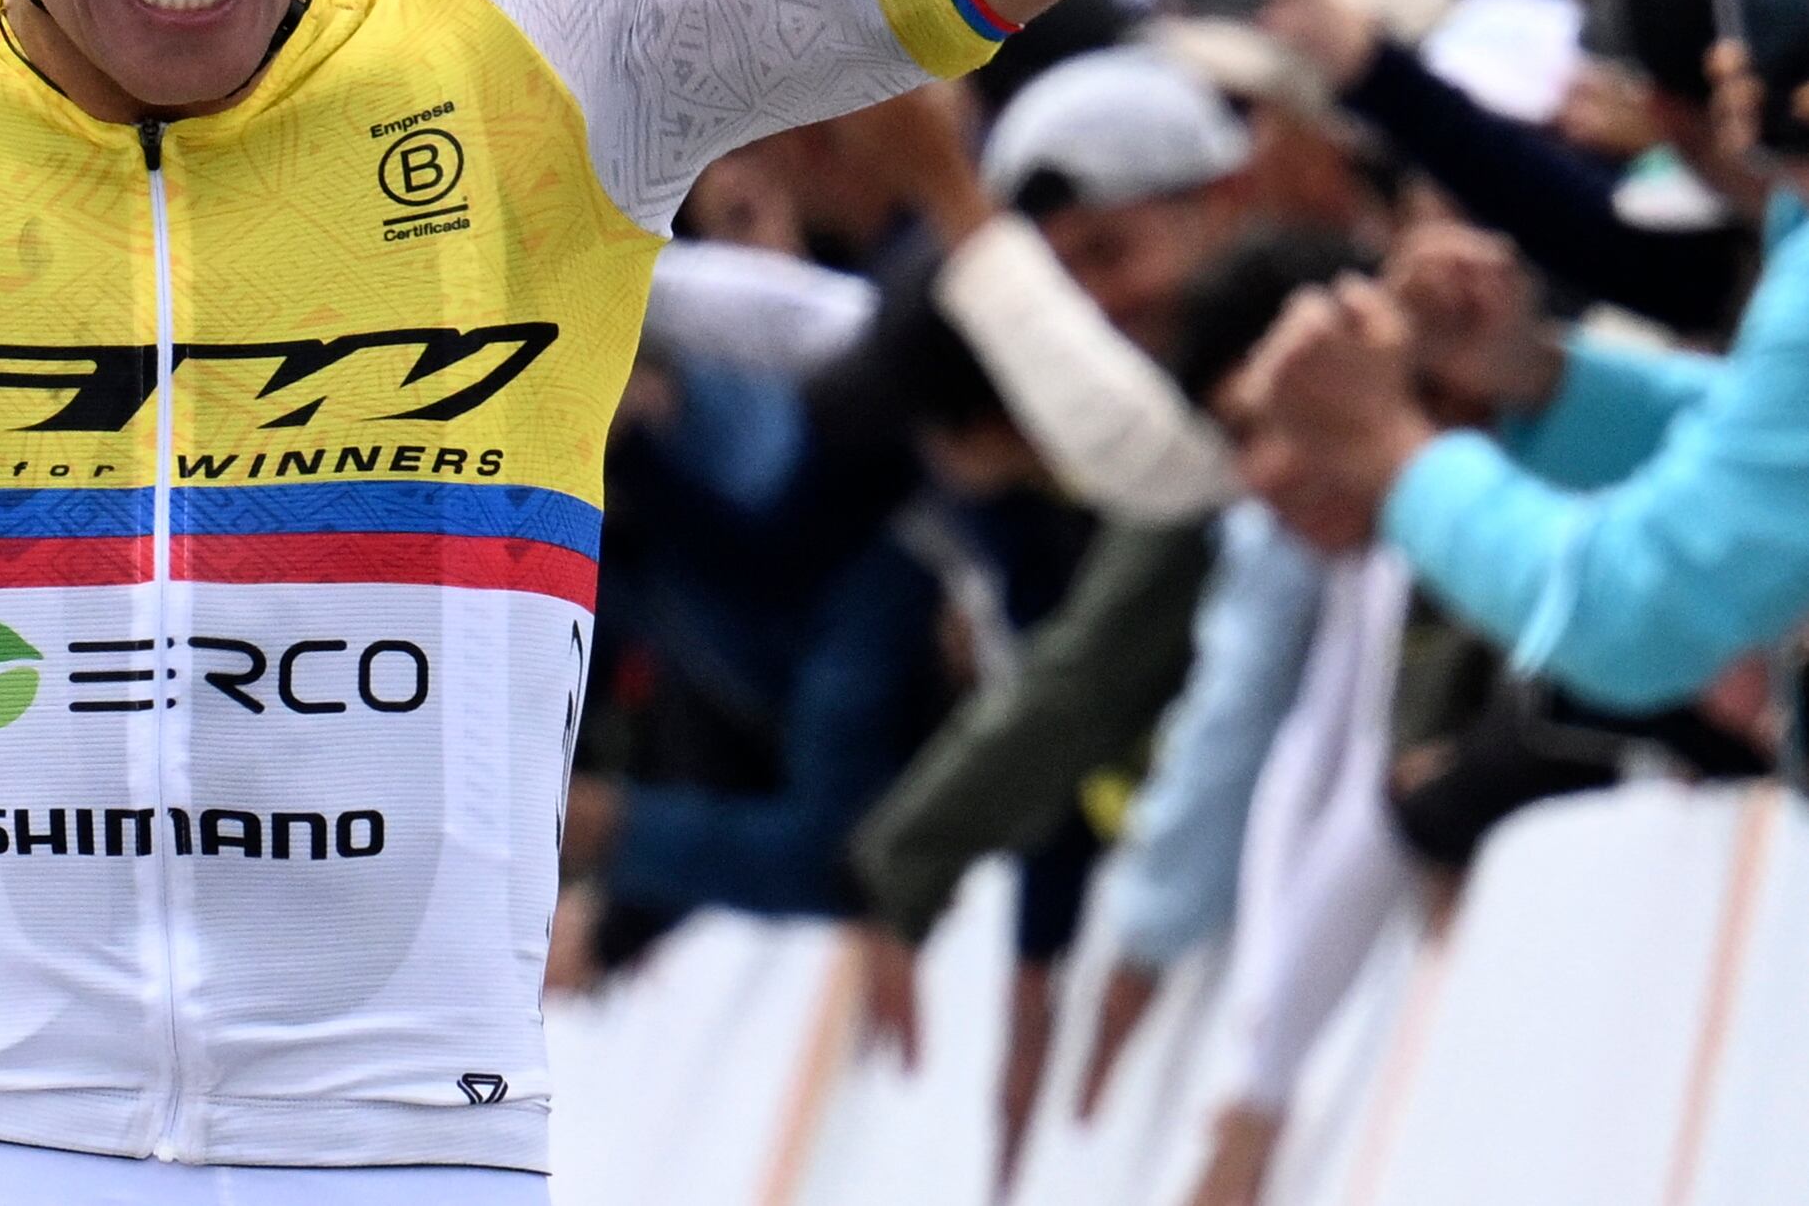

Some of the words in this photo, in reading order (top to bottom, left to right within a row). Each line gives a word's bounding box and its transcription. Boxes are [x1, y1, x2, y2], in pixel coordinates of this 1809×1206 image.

[370, 100, 455, 139] Empresa
[383, 217, 470, 242] Certificada
[12, 461, 115, 478] for
[177, 445, 505, 479] WINNERS
[67, 636, 429, 715] ERCO
